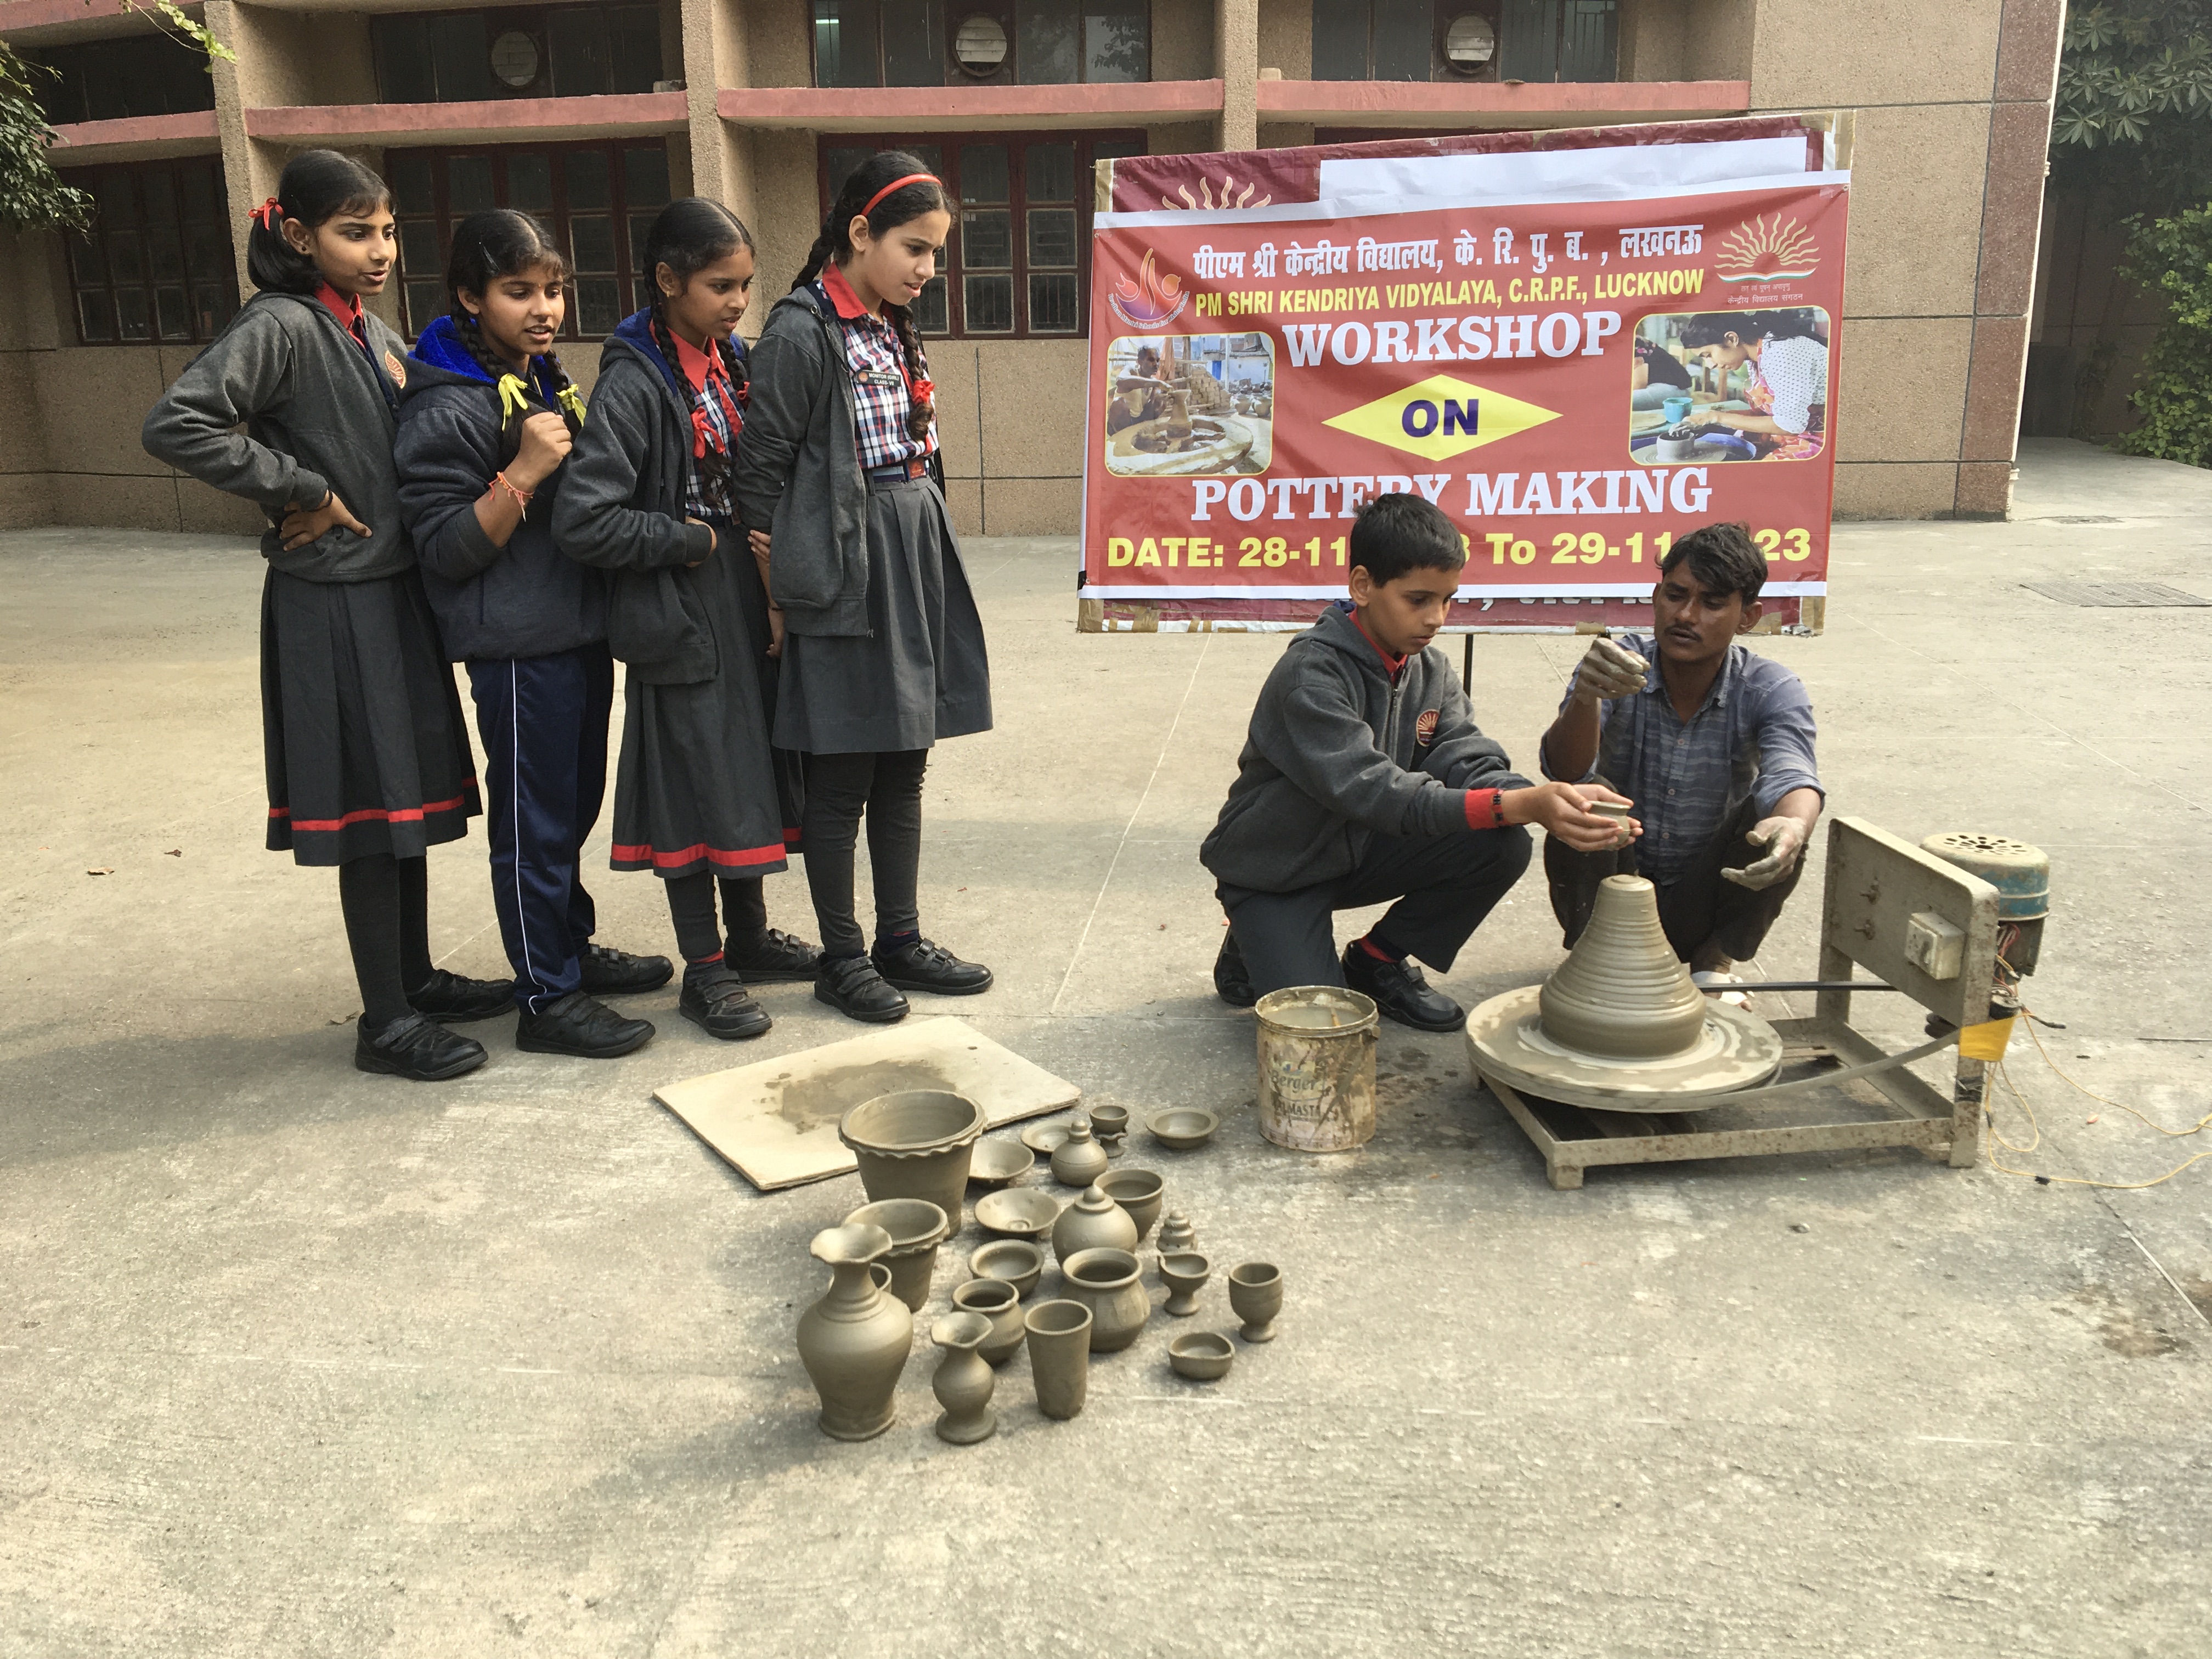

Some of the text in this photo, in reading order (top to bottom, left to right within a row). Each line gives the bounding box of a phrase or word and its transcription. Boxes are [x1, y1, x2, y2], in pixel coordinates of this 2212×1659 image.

[1193, 245, 1246, 279] पीएम
[1252, 242, 1278, 278] श्री
[1283, 240, 1351, 276] केन्द्रीय
[1356, 237, 1443, 273] विद्यालय,
[1453, 229, 1482, 266] के.
[1493, 227, 1520, 264] रि.
[1530, 233, 1554, 274] पु.
[1564, 232, 1589, 261] ब.
[1619, 224, 1703, 258] लखनऊ
[1195, 269, 1705, 317] PM SHRI KENDRIYA VIDYALAYA, C.R.P.F., LUCKNOW
[1728, 292, 1803, 304] केन्द्रीय विद्यालय संगठन
[1282, 311, 1622, 367] WORKSHOP
[1402, 399, 1479, 437] ON
[1465, 467, 1712, 516] MAKING
[1108, 538, 1223, 567] DATE:
[1485, 533, 1536, 565] To
[1550, 528, 1810, 564] 29-1123
[1271, 1070, 1316, 1093] Berger
